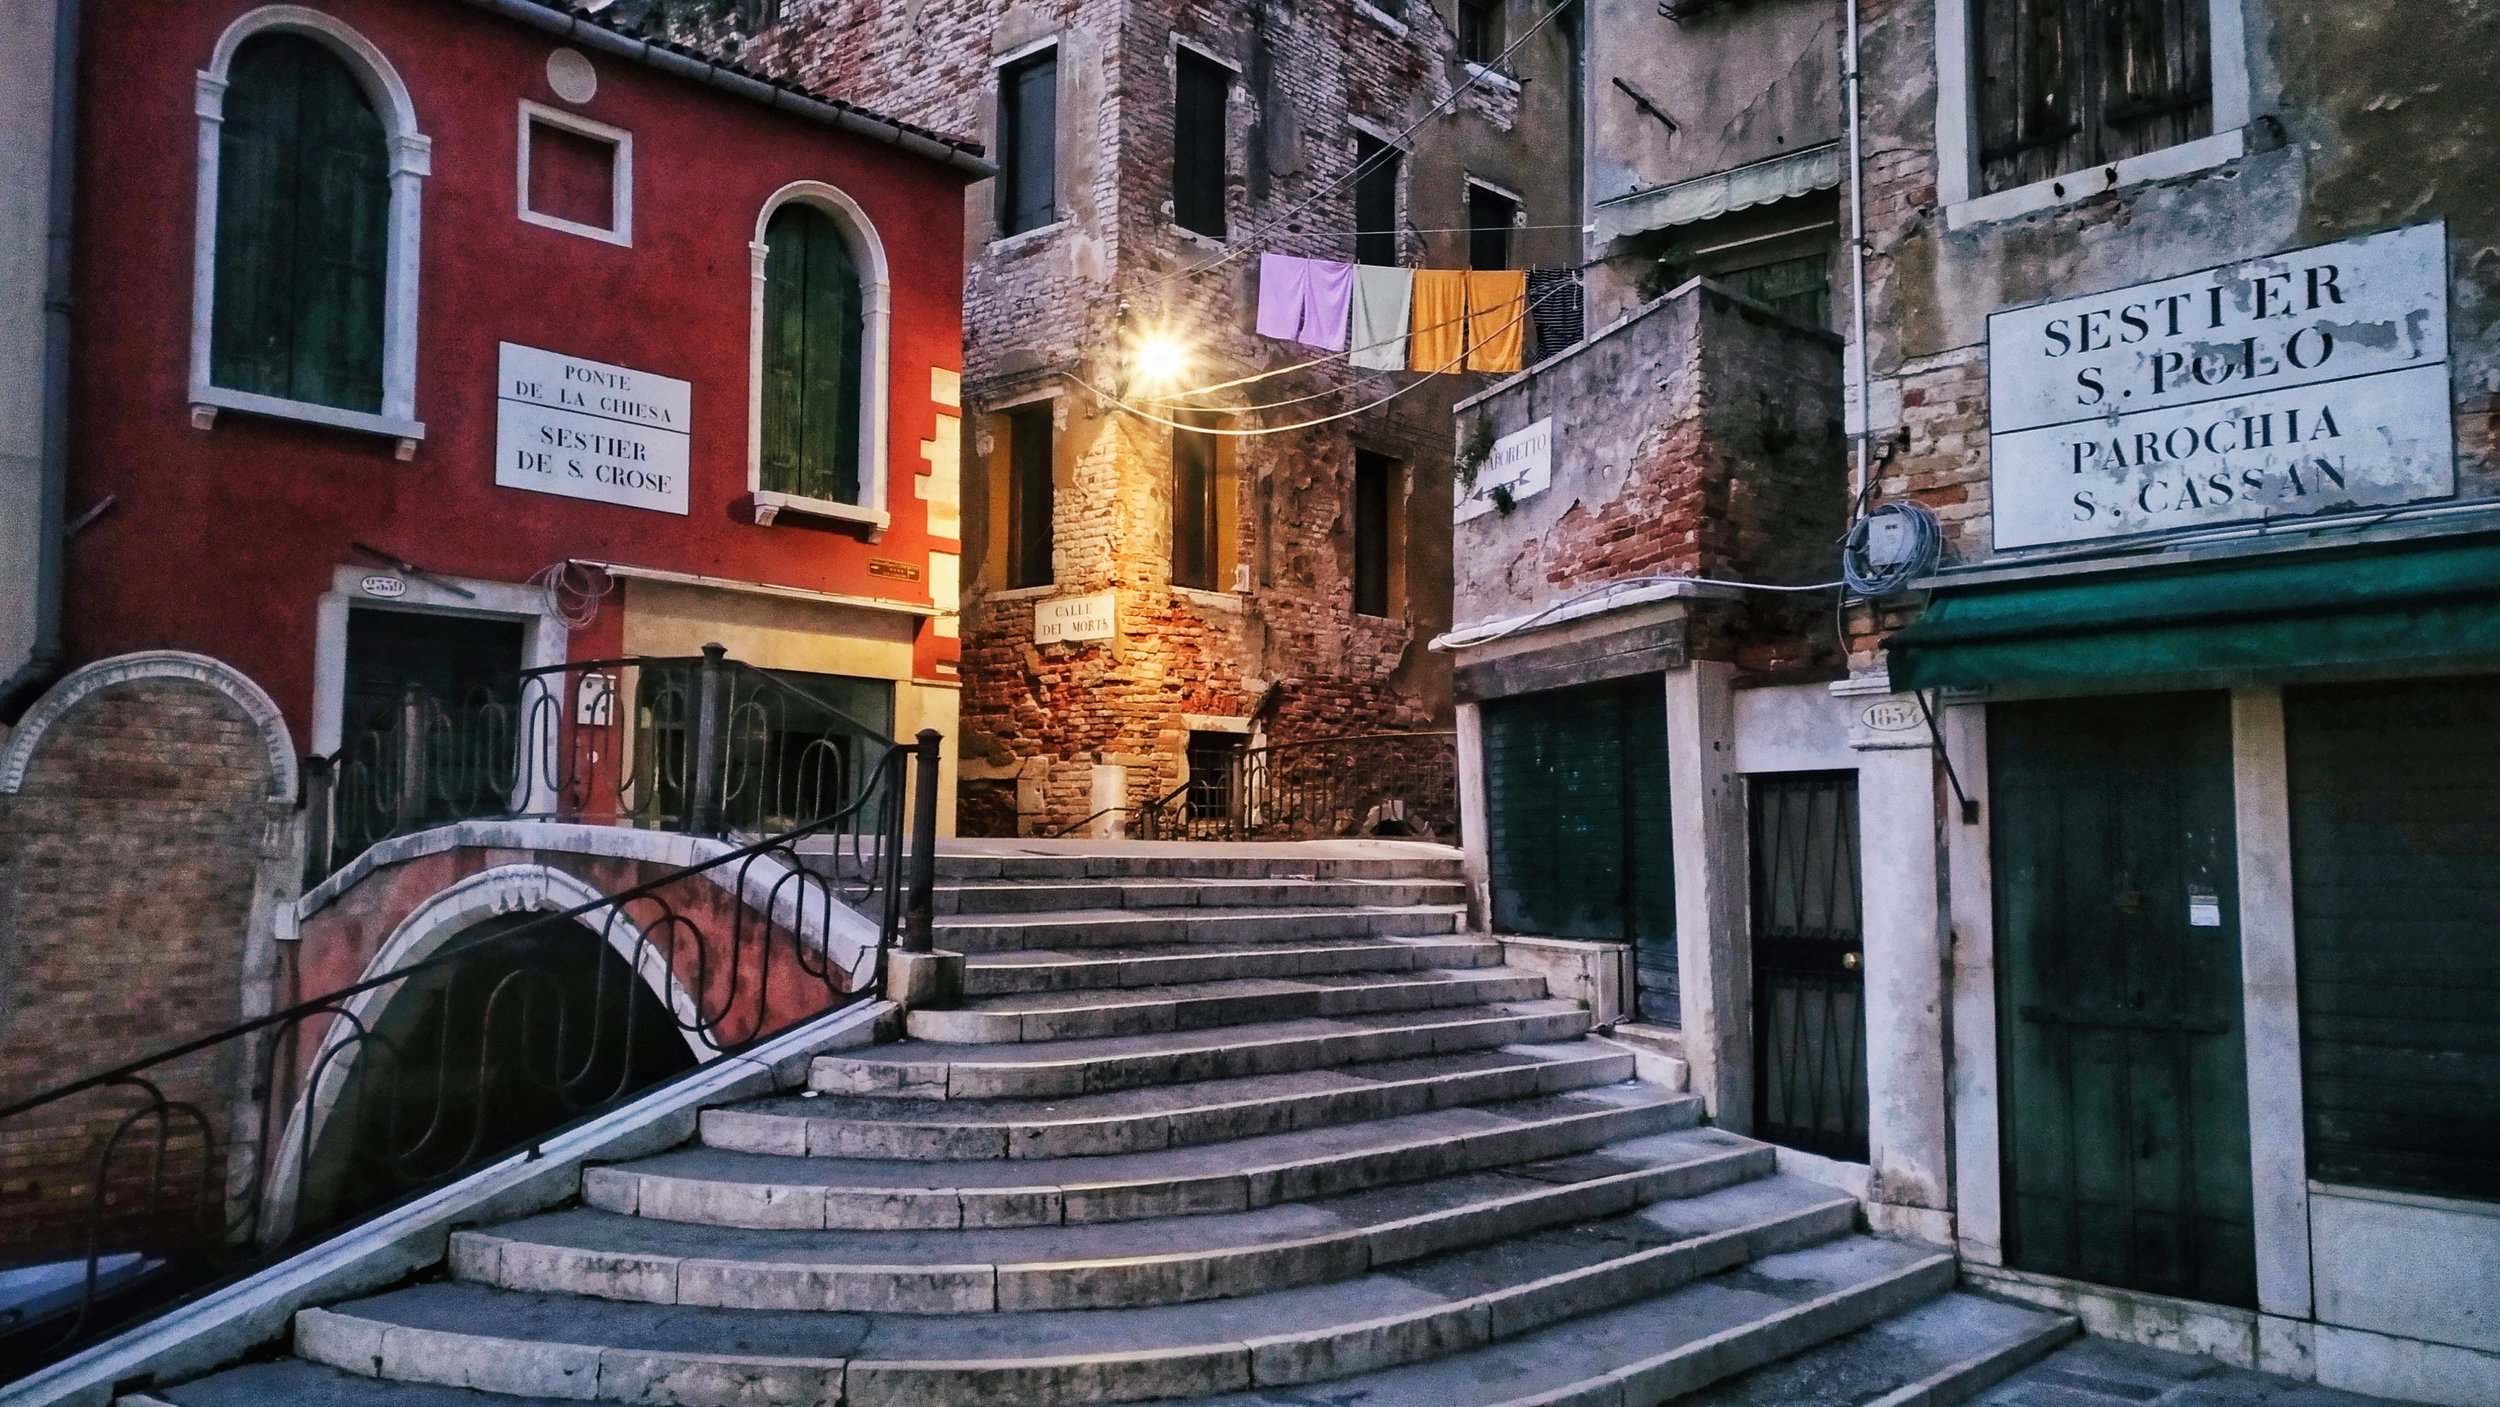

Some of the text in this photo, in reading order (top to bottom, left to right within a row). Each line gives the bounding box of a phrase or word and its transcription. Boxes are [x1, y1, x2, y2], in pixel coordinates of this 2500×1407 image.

[2044, 264, 2347, 358] SESTIER
[565, 365, 631, 391] PONTE
[2152, 326, 2335, 395] POLO
[516, 380, 672, 423] DE LA CHIESA
[541, 425, 647, 462] SESTIER
[2072, 405, 2341, 474] PAROCHIA
[517, 450, 552, 474] DE
[595, 464, 672, 494] CROSE
[2138, 455, 2347, 514] CASSAN
[1043, 623, 1061, 636] DEI
[1055, 603, 1092, 617] CALLE
